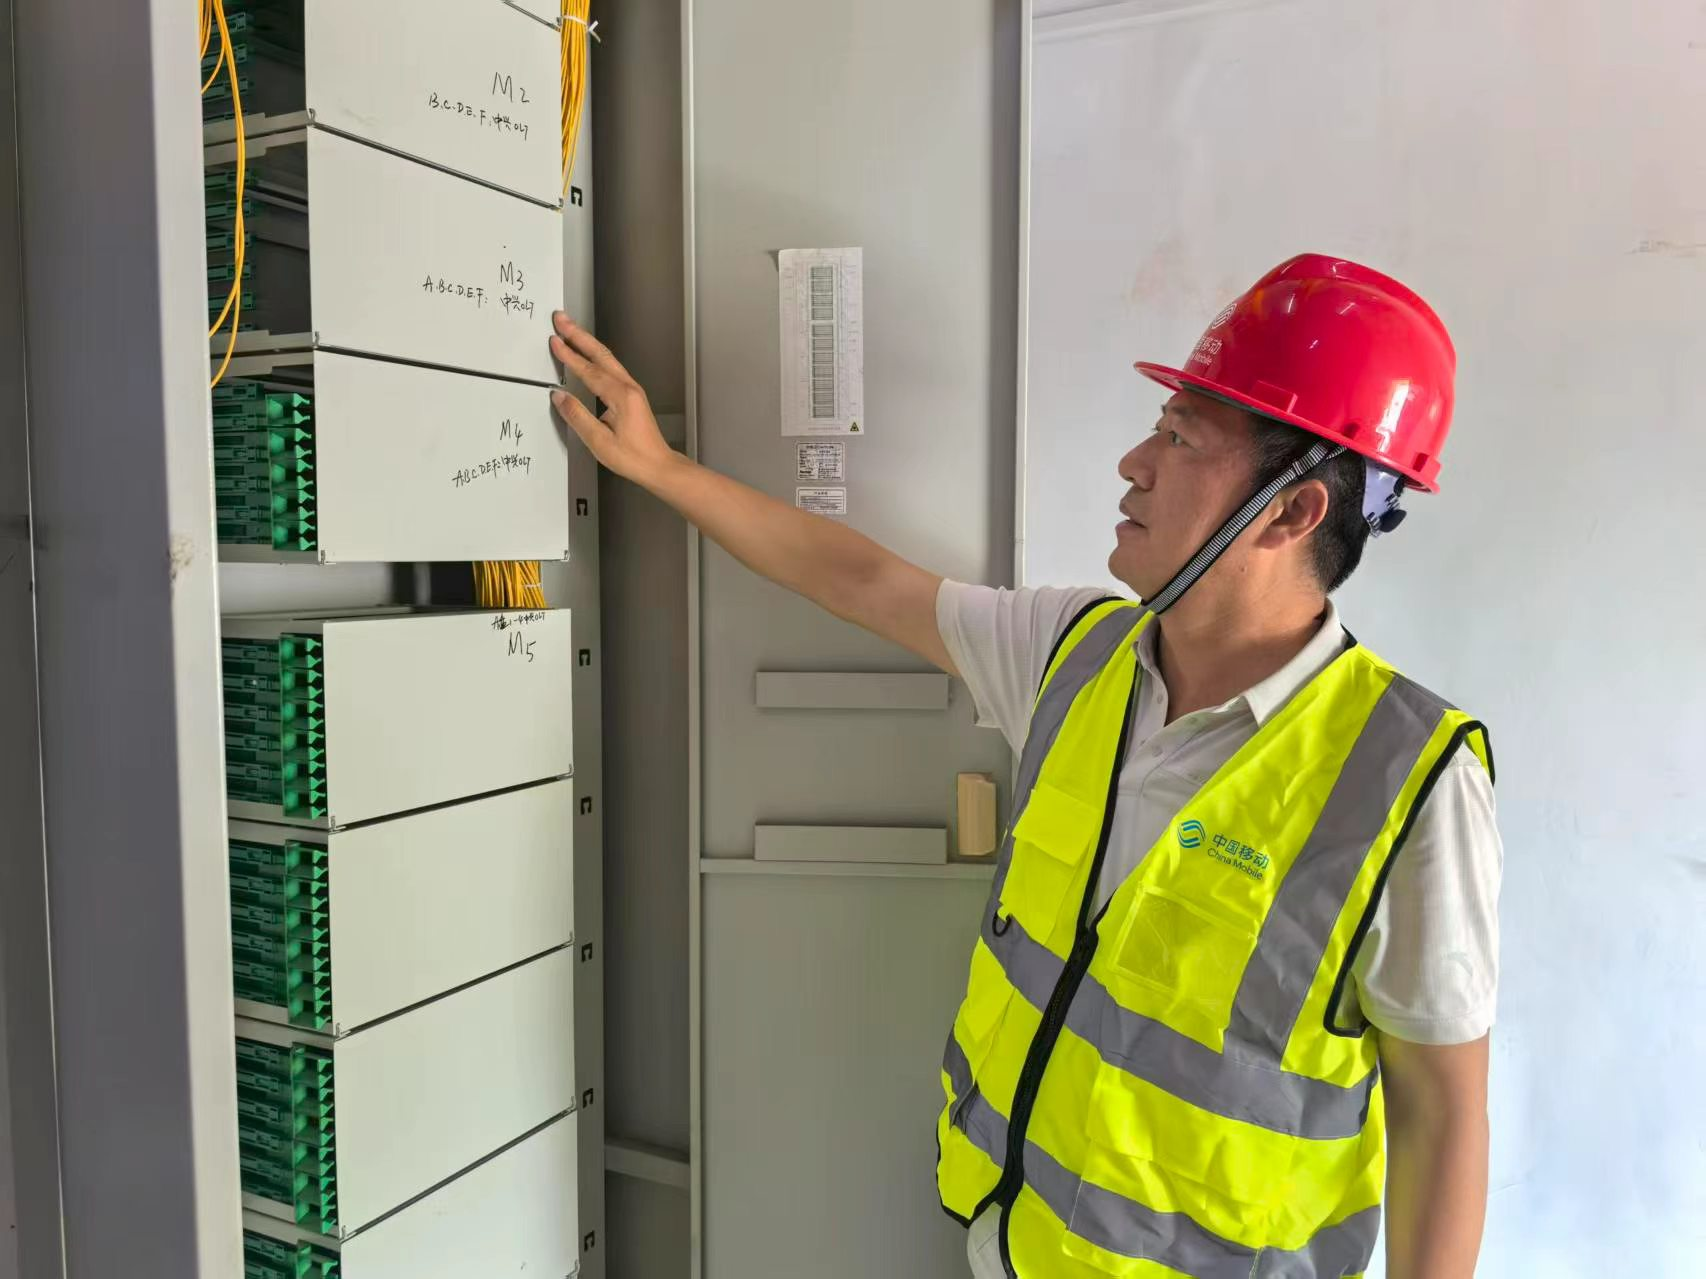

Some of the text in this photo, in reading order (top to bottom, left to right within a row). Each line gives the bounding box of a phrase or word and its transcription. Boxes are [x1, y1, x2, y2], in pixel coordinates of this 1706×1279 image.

[493, 71, 530, 103] M2
[500, 261, 524, 291] M3
[499, 418, 524, 447] M4
[508, 629, 537, 663] M5
[1207, 847, 1263, 881] China Mobile
[1212, 833, 1269, 870] 中国移动
